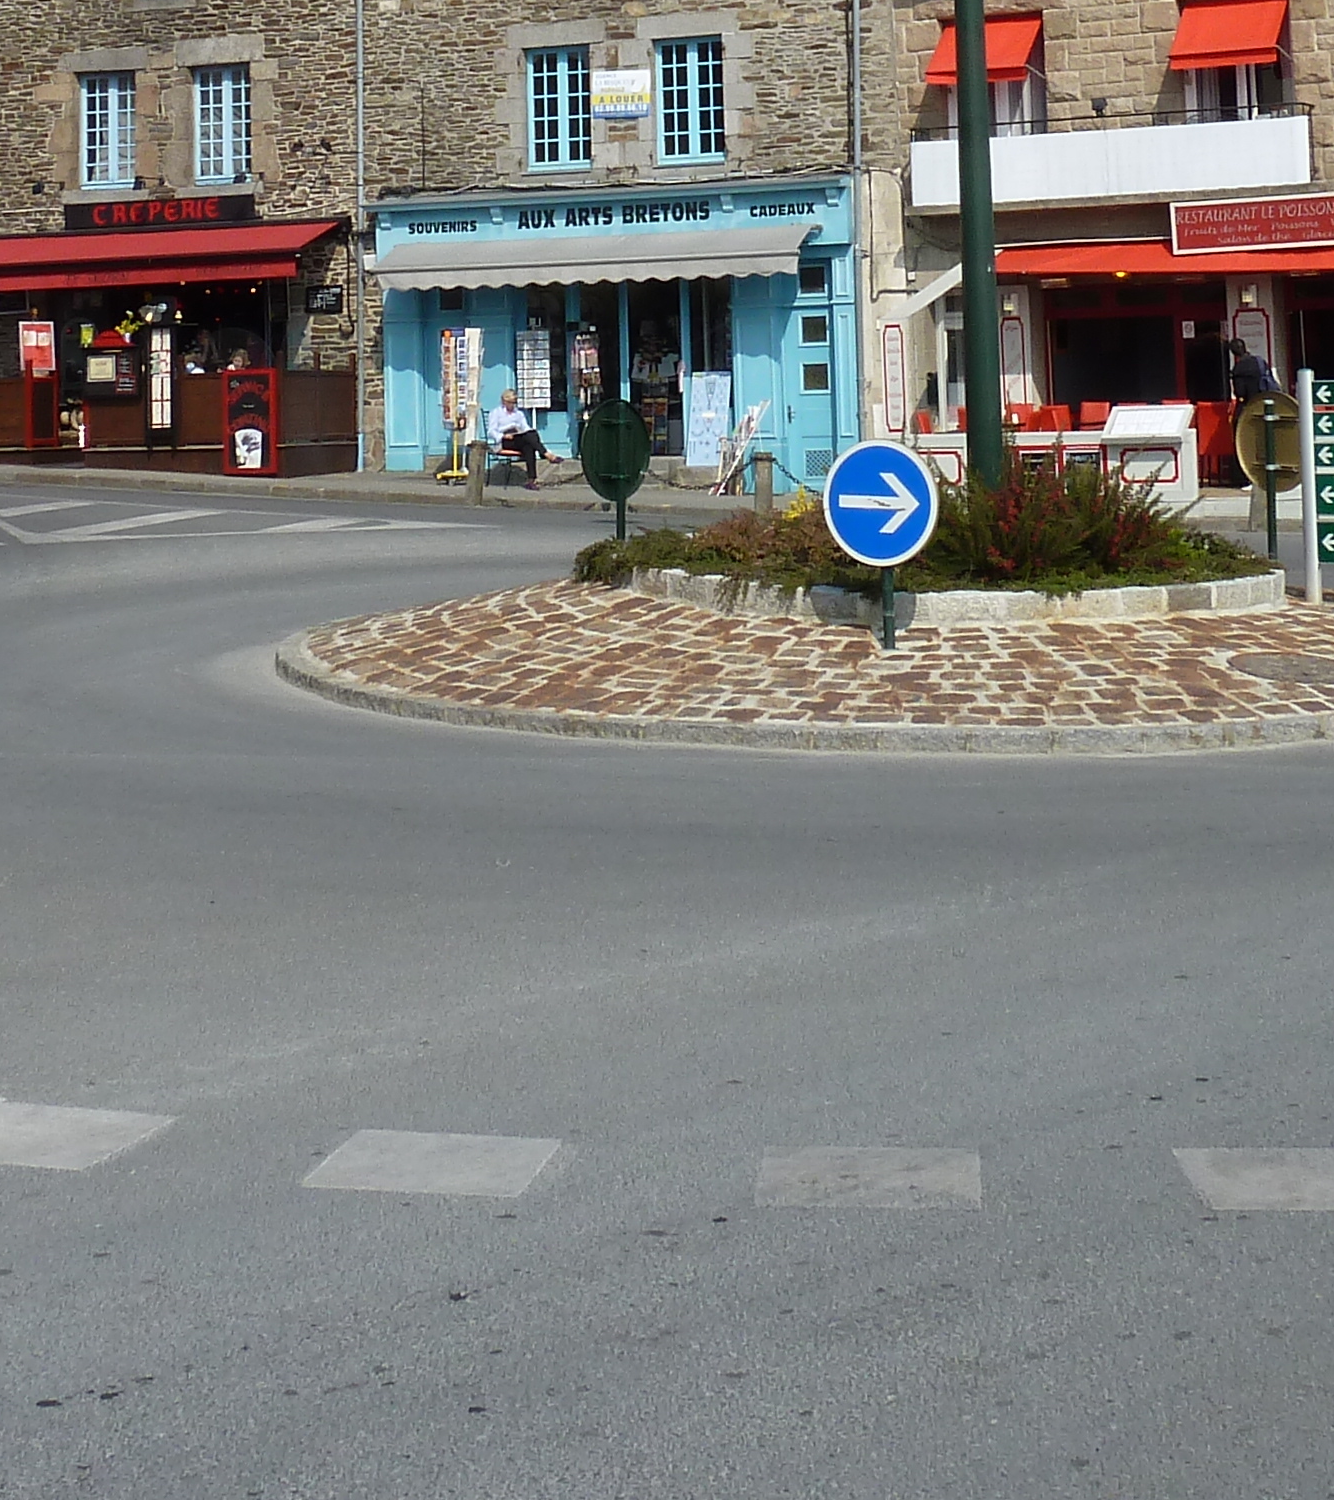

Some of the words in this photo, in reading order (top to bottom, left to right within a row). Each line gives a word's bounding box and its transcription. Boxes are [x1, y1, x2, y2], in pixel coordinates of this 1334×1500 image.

[609, 94, 644, 103] LOUER
[92, 198, 222, 227] CREPERIE
[517, 210, 555, 230] AUX
[565, 207, 613, 227] ARTS
[622, 201, 710, 224] BRETONS
[749, 202, 816, 218] CADEAUX
[1176, 206, 1257, 225] RESTAURANT
[1261, 206, 1275, 219] LE
[408, 220, 478, 235] SOUVENIRS
